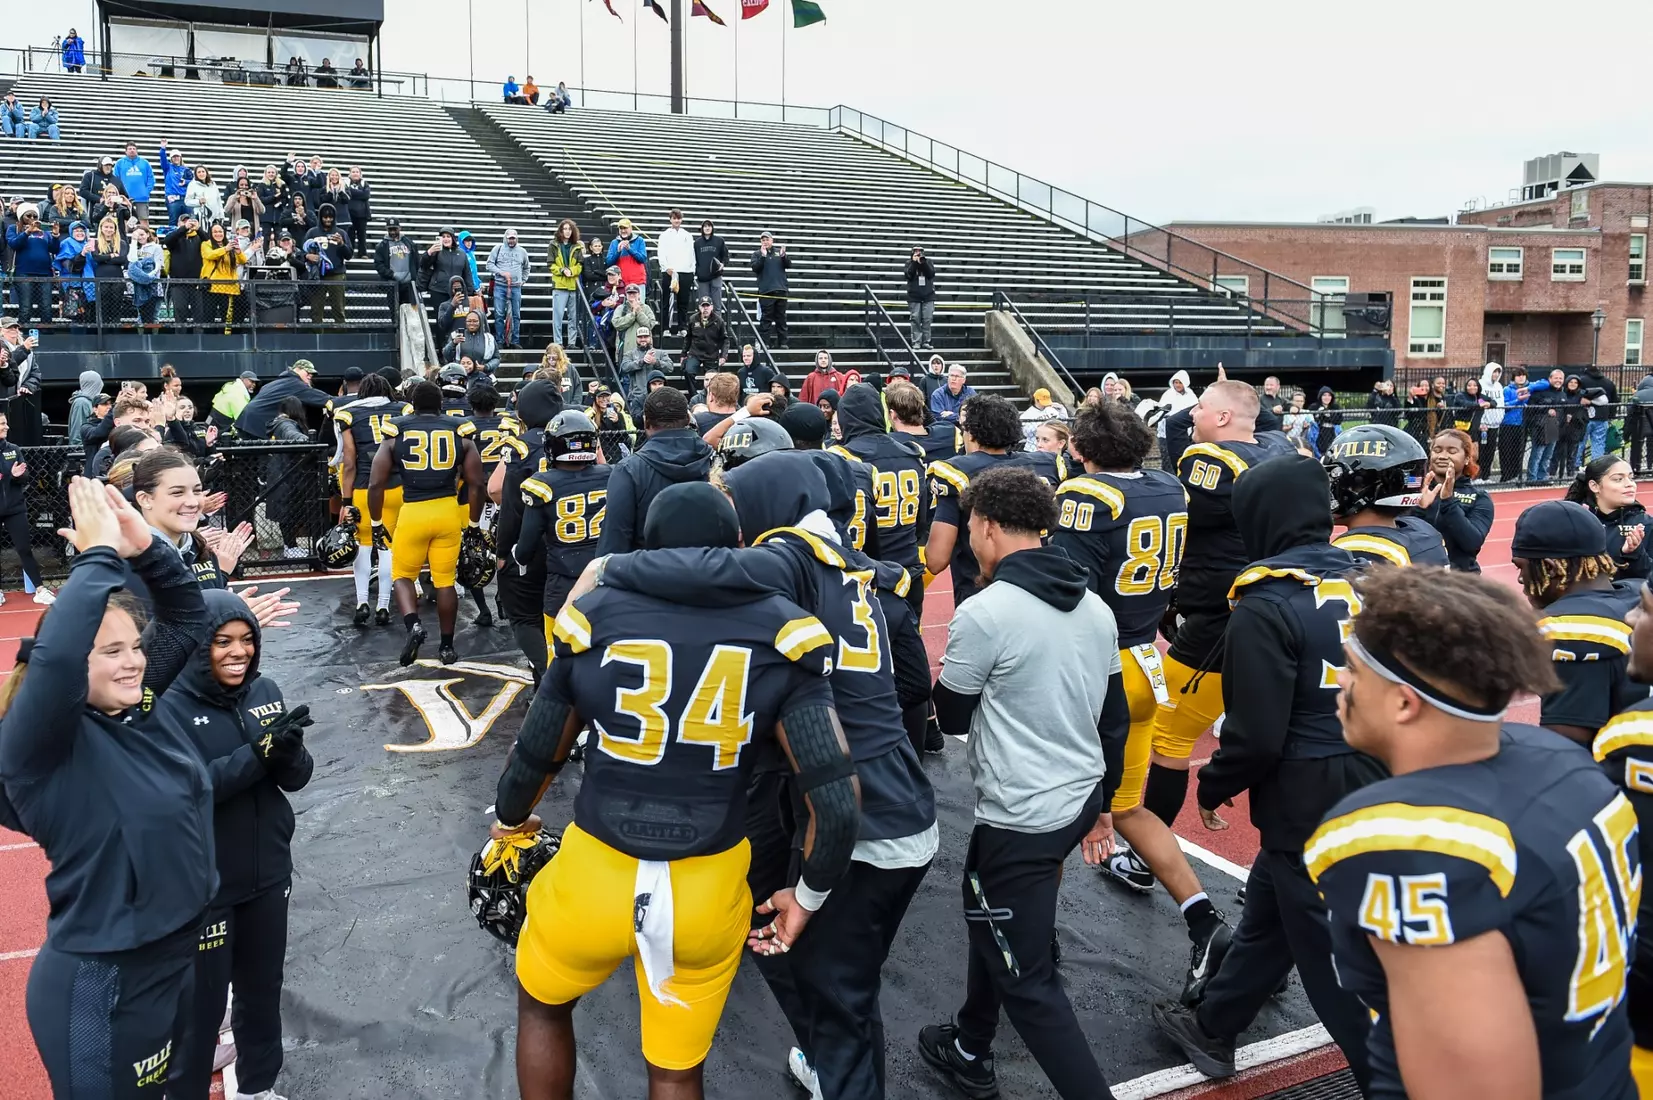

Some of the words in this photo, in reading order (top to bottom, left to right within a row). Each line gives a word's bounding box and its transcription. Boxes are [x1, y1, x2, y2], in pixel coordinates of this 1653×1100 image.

[401, 429, 457, 471] 30
[1332, 440, 1388, 460] VILLE
[1188, 459, 1222, 491] 60
[555, 489, 608, 543] 82
[876, 469, 920, 528] 98
[1059, 498, 1095, 532] 80
[191, 560, 216, 574] VILLE
[327, 546, 353, 564] VILLE
[1114, 511, 1189, 597] 80
[248, 700, 283, 720] VILLE
[593, 639, 755, 771] 34
[1358, 872, 1455, 947] 45
[132, 1039, 172, 1078] VILLE
